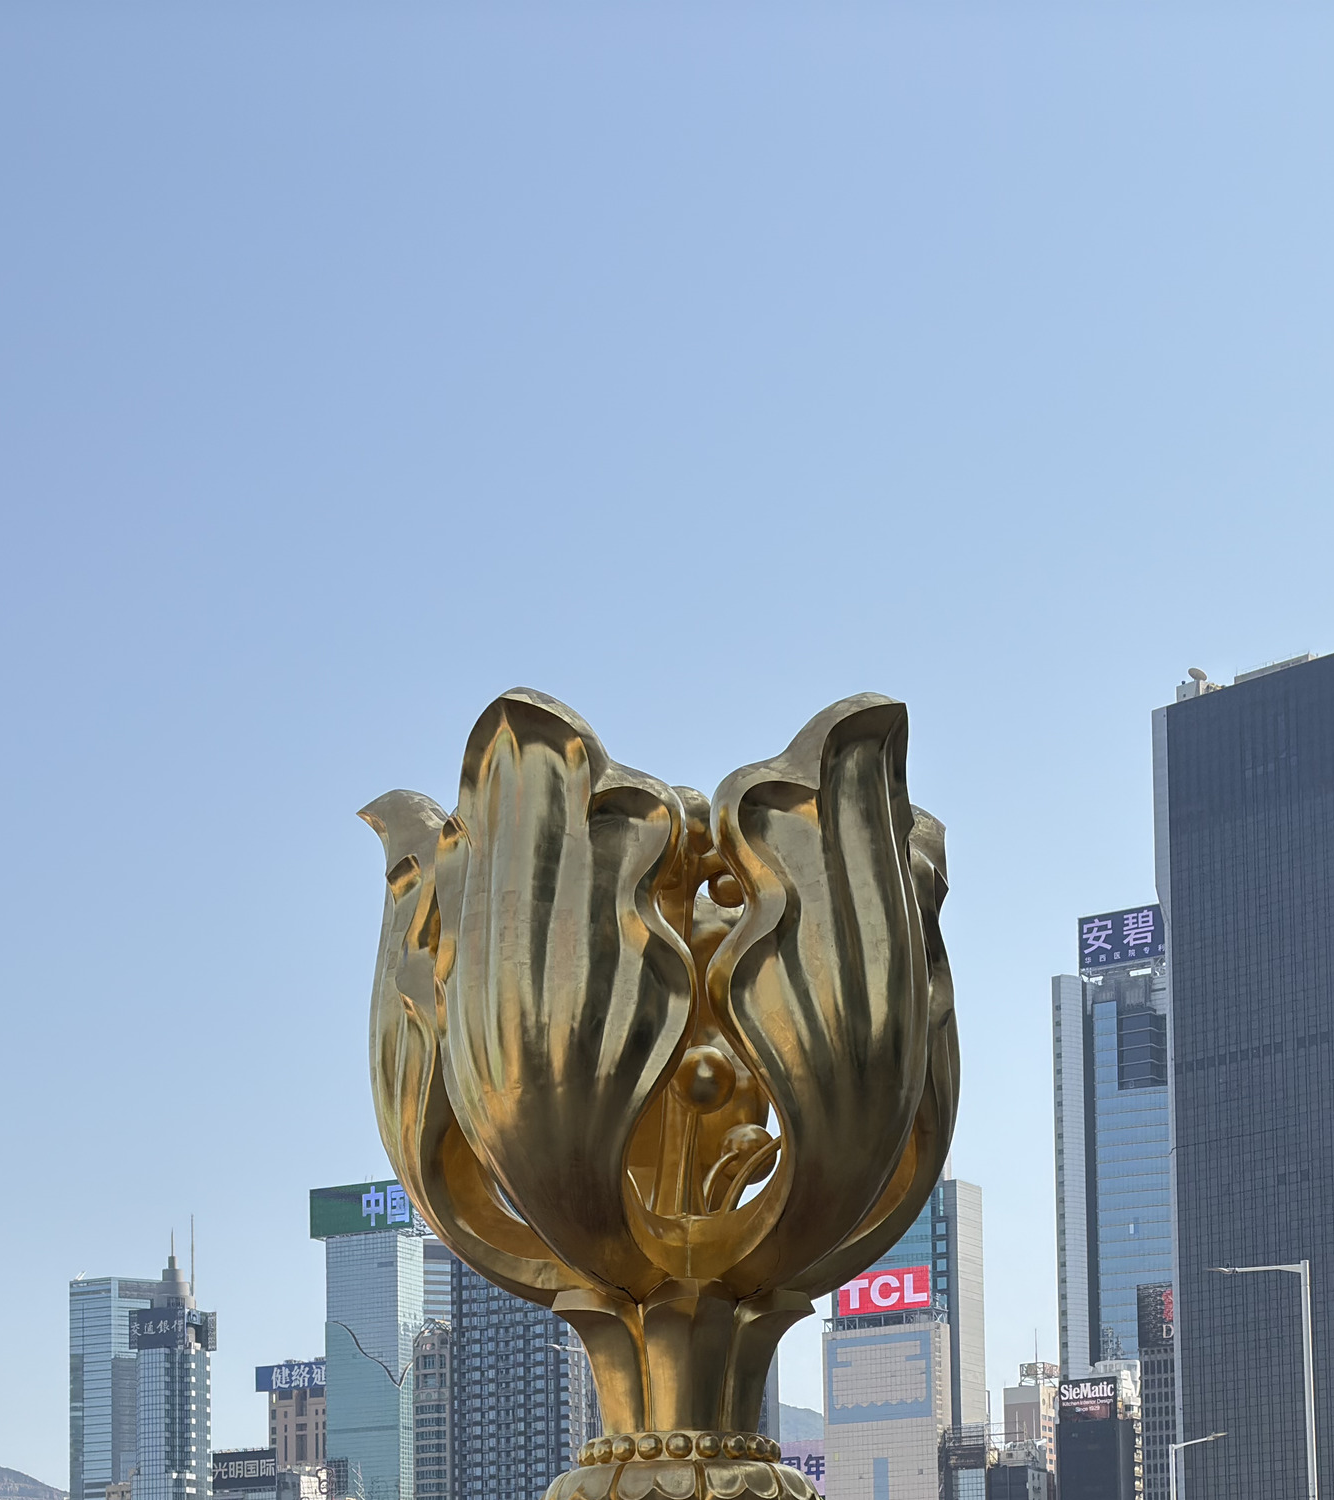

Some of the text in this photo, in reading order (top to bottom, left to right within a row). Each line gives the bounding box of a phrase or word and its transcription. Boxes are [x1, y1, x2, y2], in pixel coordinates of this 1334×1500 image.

[1082, 909, 1155, 954] 安碧
[839, 1273, 928, 1310] TCL
[1060, 1381, 1115, 1400] SieMatic
[212, 1458, 276, 1480] 光明国际
